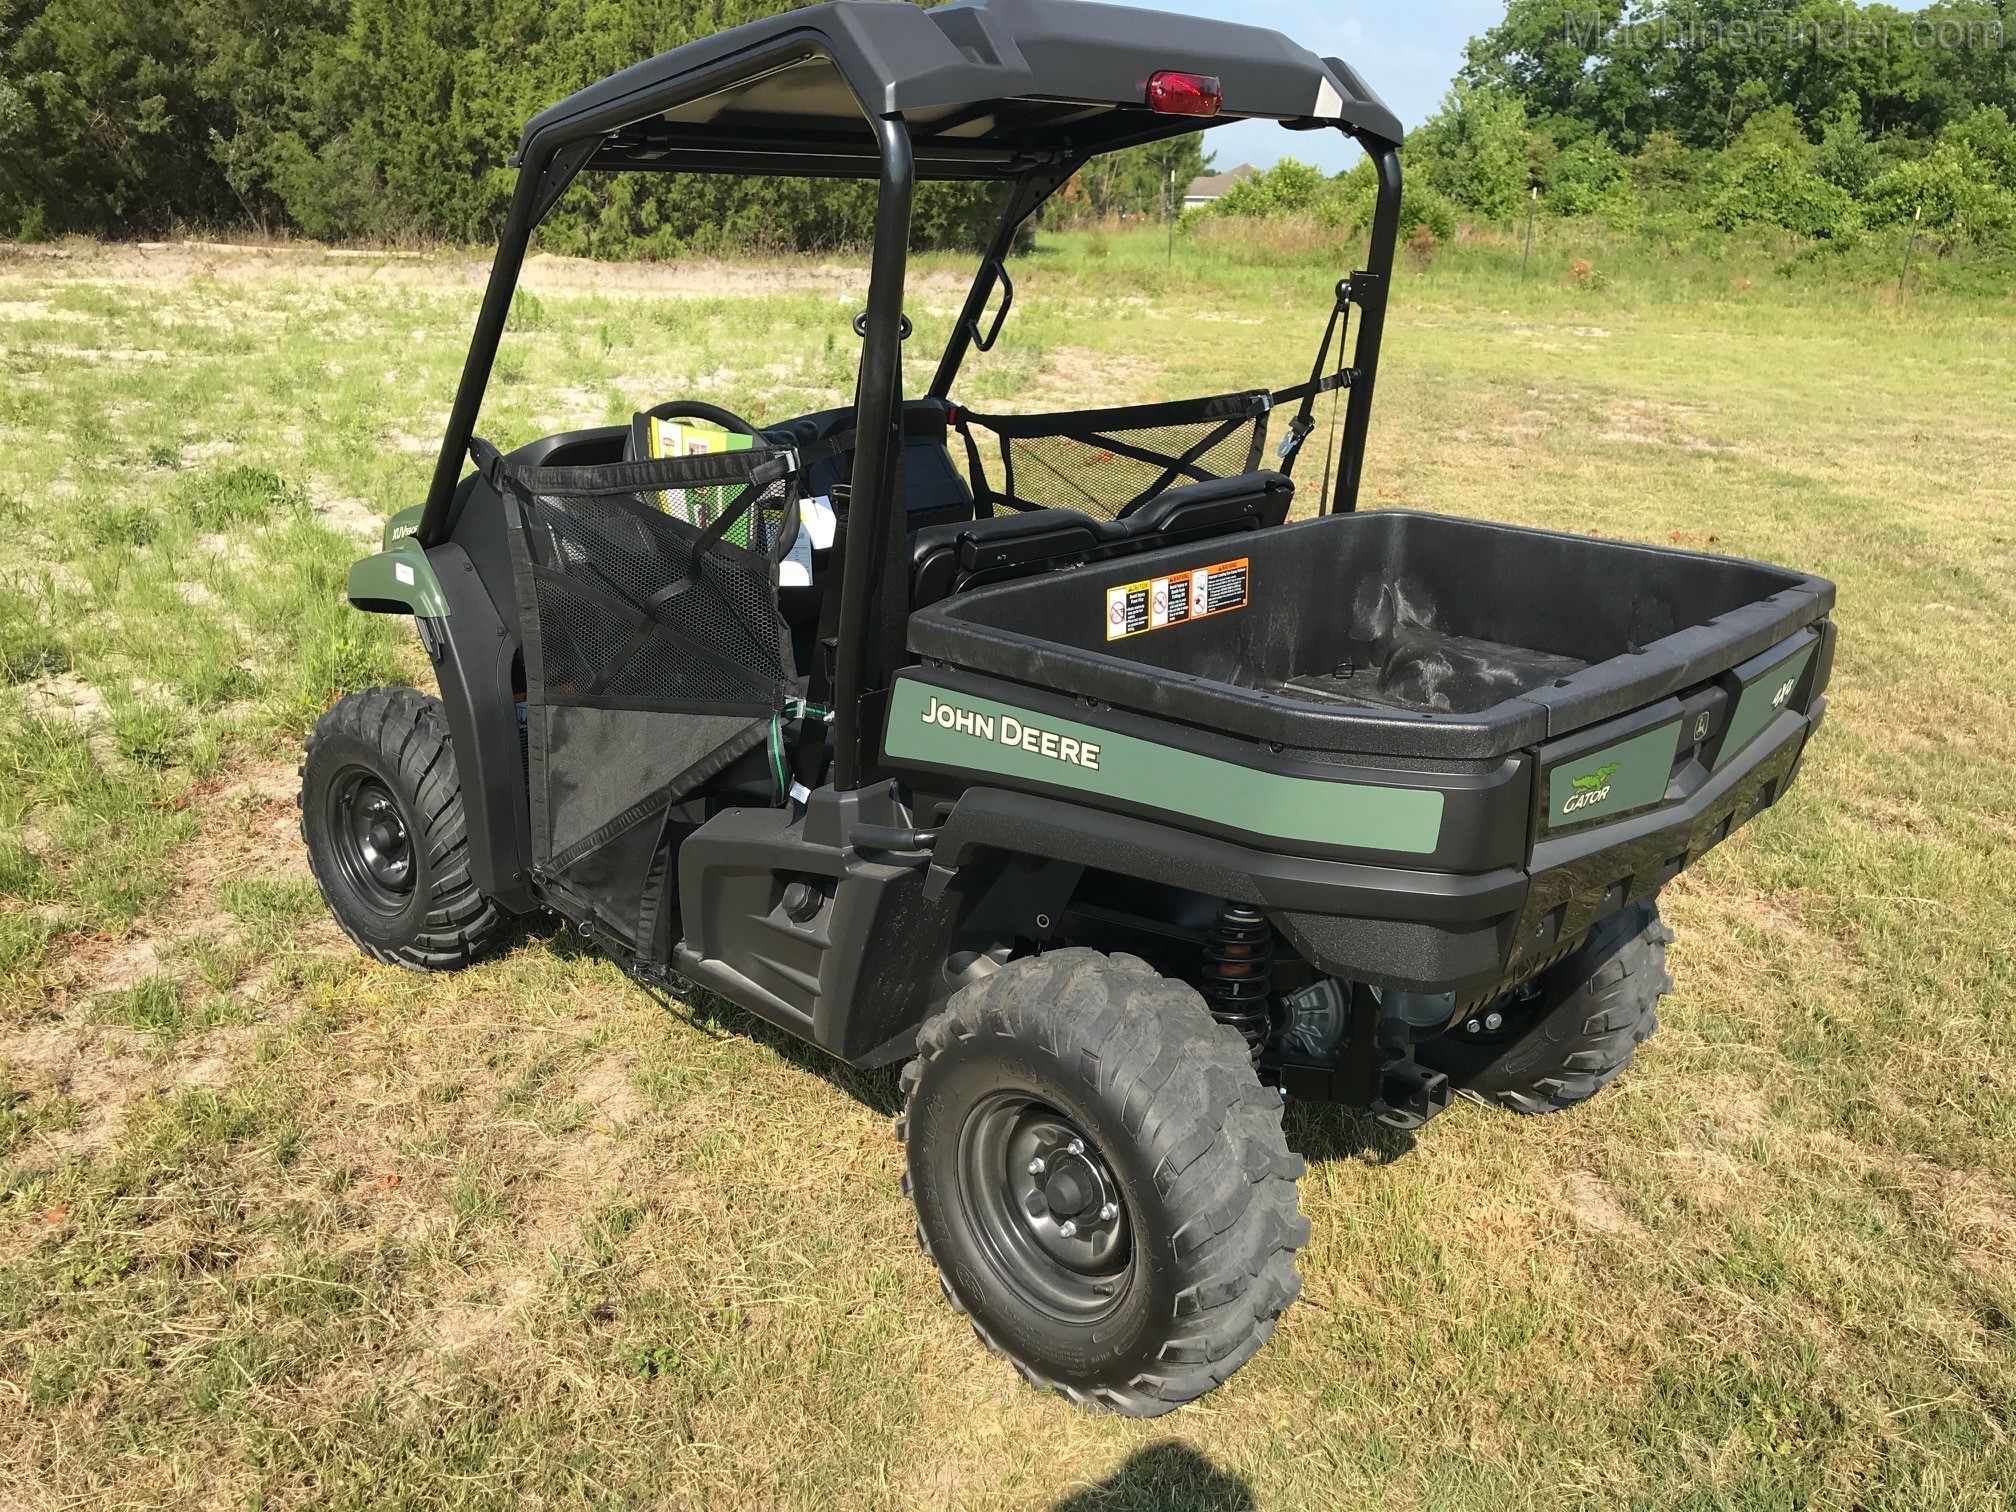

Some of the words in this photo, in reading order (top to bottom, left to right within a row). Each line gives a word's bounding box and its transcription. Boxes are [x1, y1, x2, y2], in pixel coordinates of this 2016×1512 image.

[1173, 572, 1190, 581] WARNING
[1132, 582, 1148, 591] CAUTION
[921, 696, 995, 742] JOHN
[1000, 714, 1101, 772] DEERE
[1562, 785, 1611, 814] GATOR
